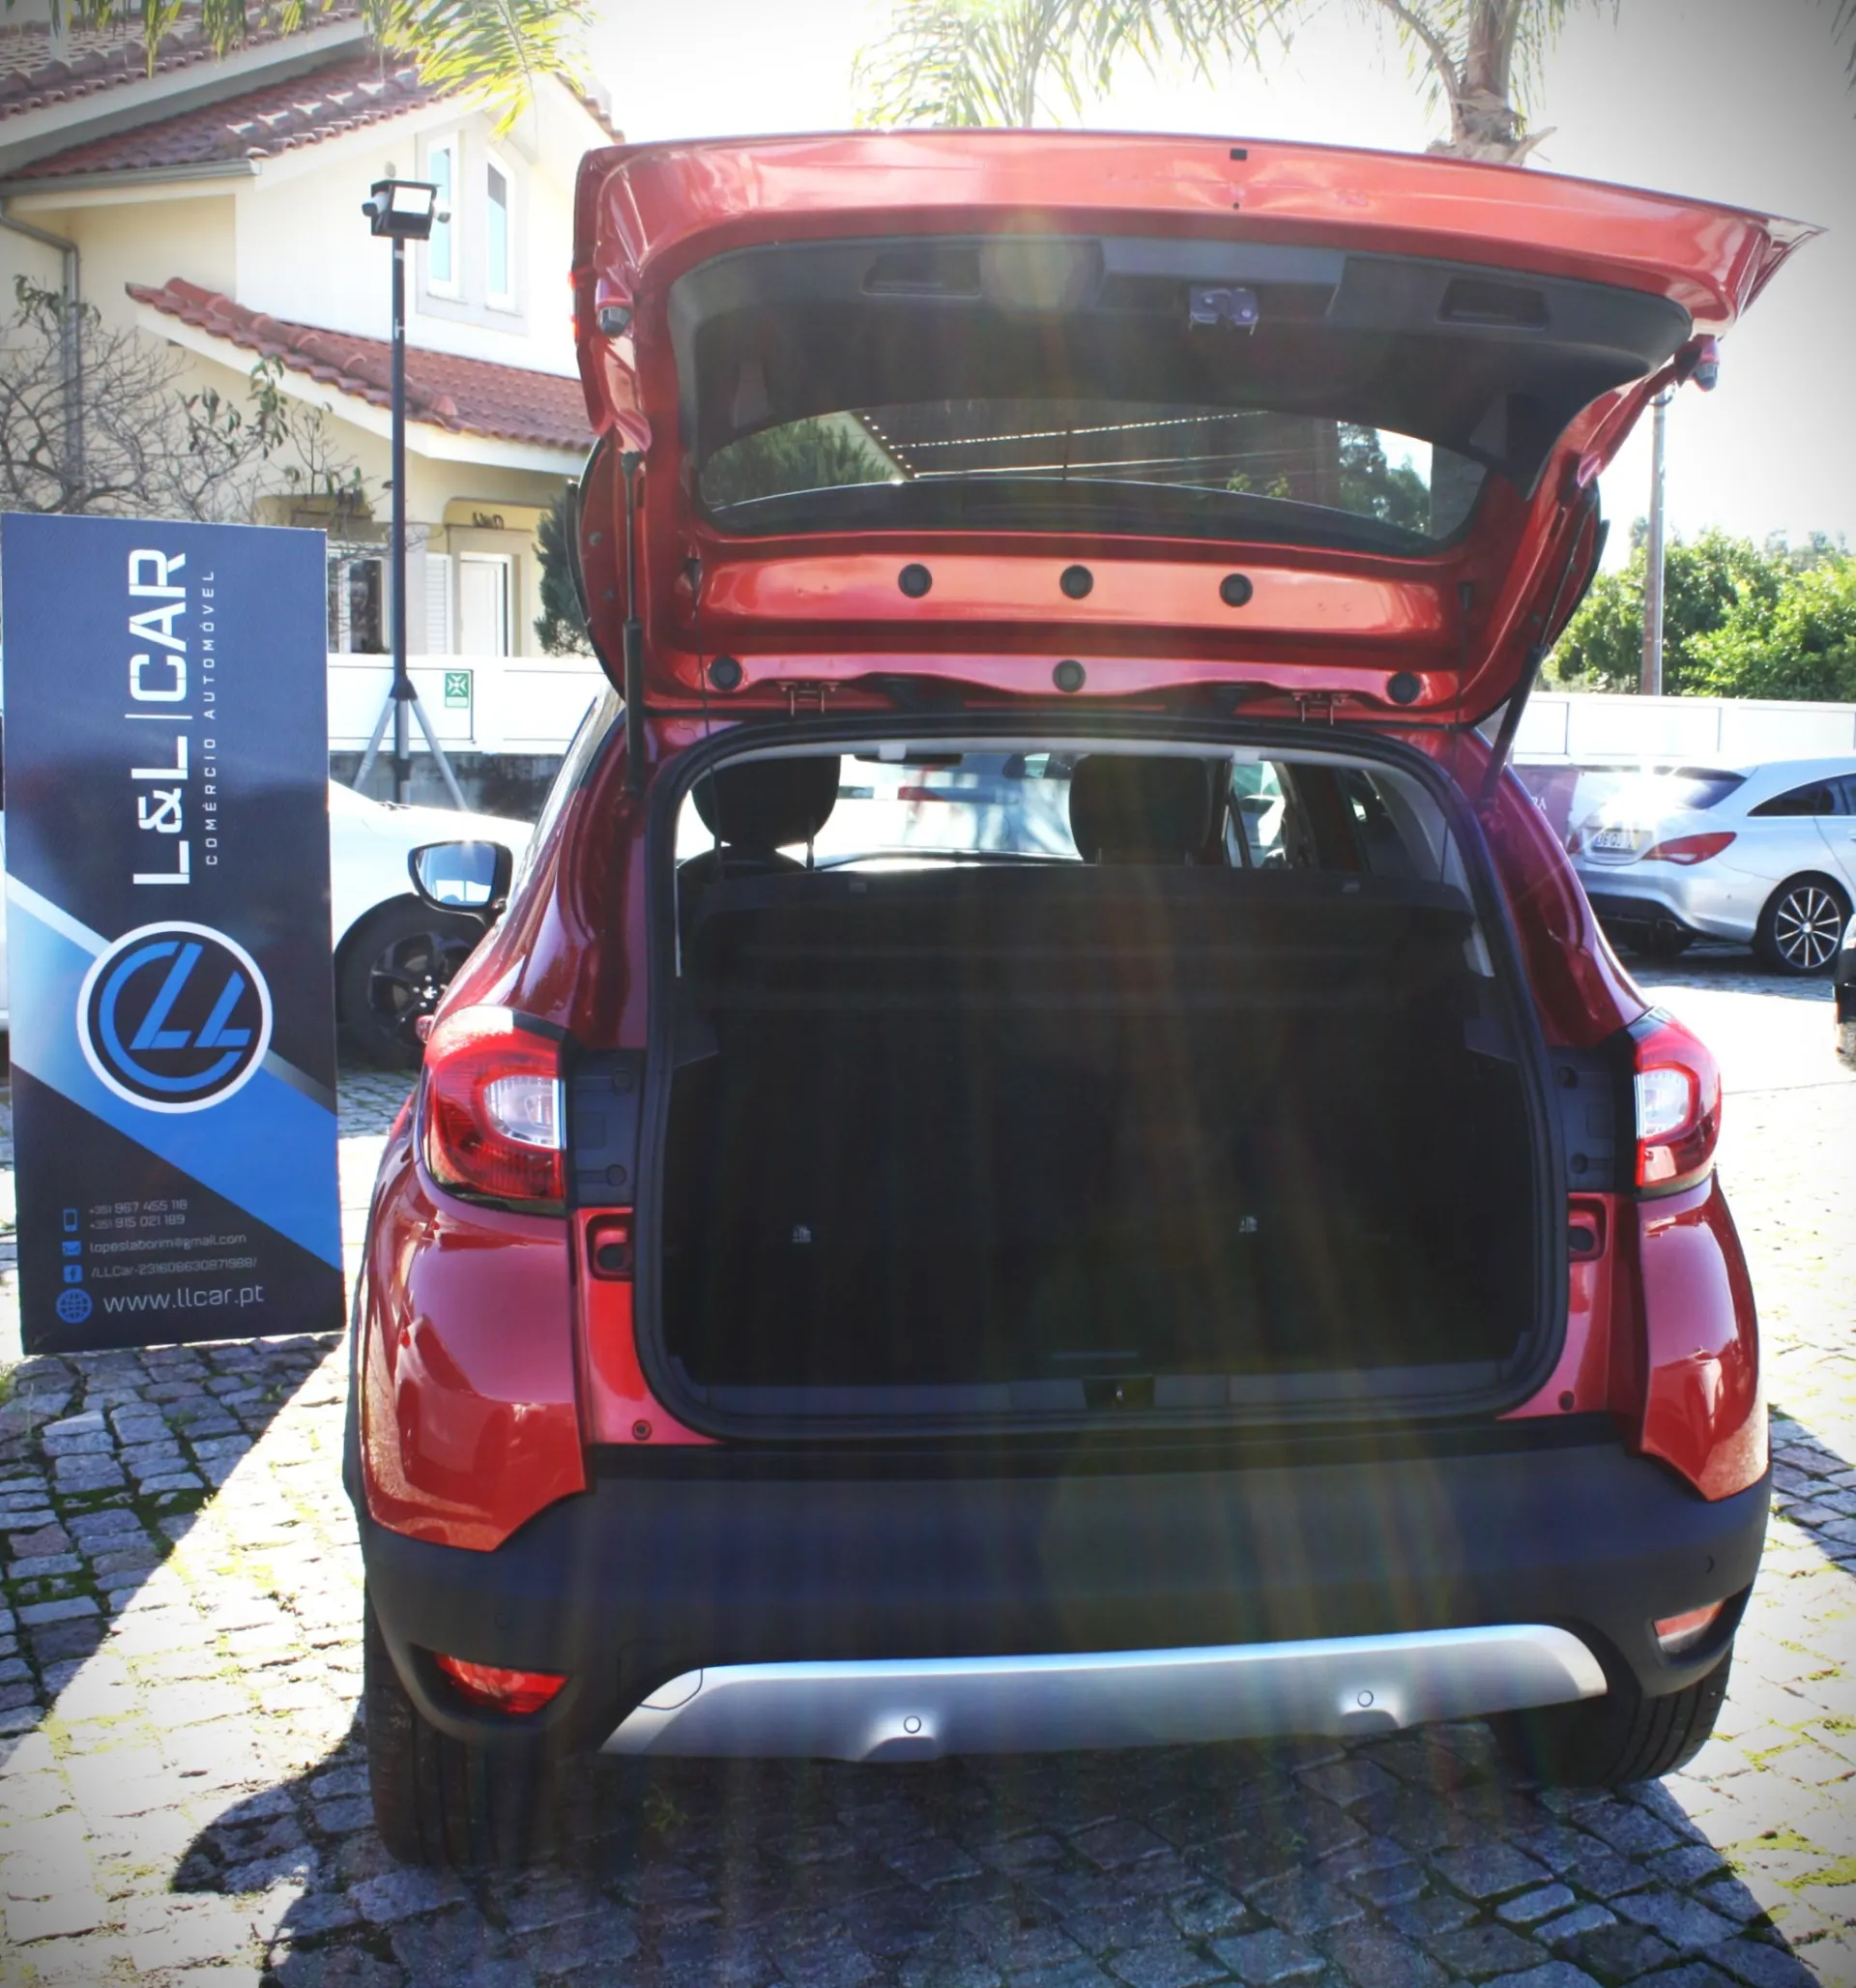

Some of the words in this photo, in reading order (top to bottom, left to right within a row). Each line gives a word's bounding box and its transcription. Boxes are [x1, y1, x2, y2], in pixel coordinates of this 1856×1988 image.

[201, 570, 217, 719] AUTOMÓVEL
[201, 738, 218, 865] COMÉRCIO
[115, 1216, 137, 1228] 915
[139, 1215, 161, 1227] 021
[164, 1213, 186, 1225] 189
[102, 1284, 265, 1314] www.llcar.pt
